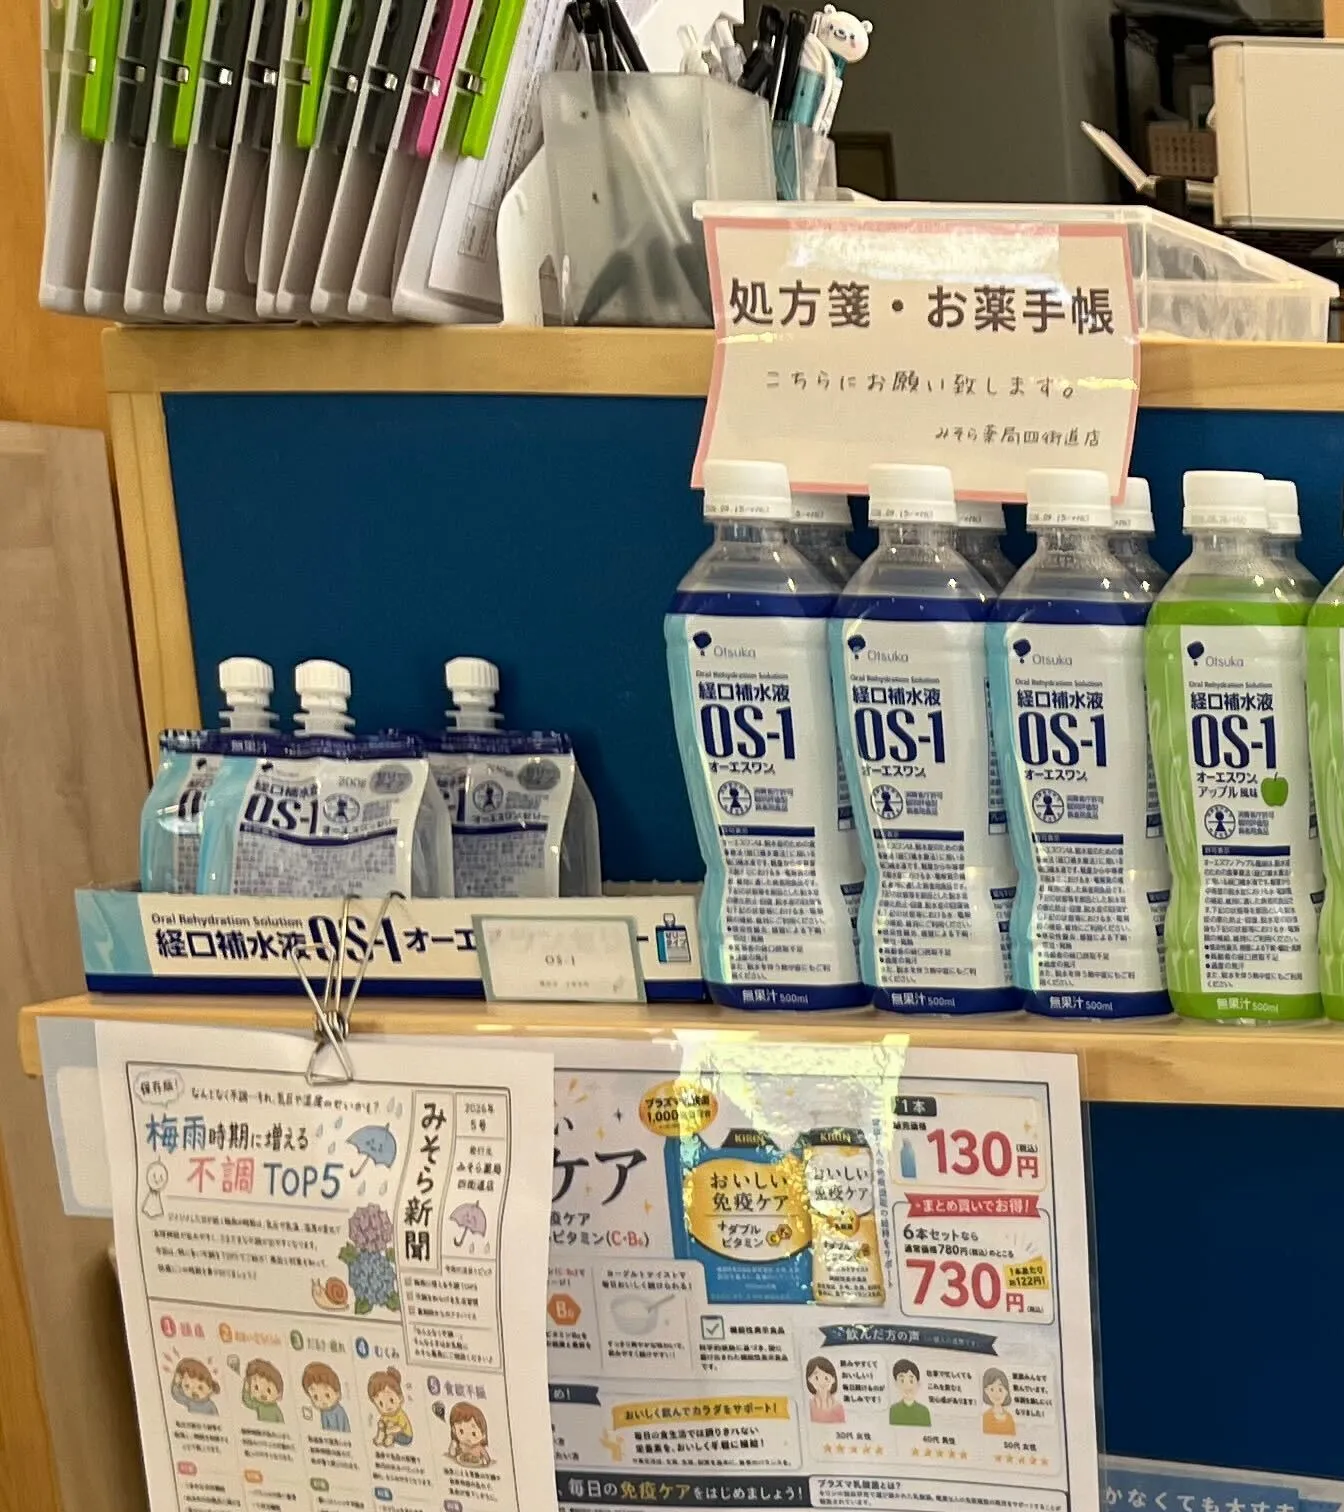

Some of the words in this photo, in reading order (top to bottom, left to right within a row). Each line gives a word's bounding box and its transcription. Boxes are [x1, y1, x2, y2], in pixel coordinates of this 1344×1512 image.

[729, 277, 1116, 336] 処方箋・お薬手帳
[766, 369, 1075, 399] こちらにお願い致します。
[935, 426, 1101, 447] みそら薬局四街道店
[699, 682, 790, 702] 経口補水液
[852, 684, 941, 706] 経口補水液
[1017, 690, 1104, 710] 経口補水液
[1191, 692, 1273, 711] 経口補水液
[700, 703, 796, 760] OS-1
[854, 706, 946, 764] OS-1
[1017, 711, 1107, 768] OS-1
[1191, 714, 1277, 770] OS-1
[1198, 786, 1258, 800] アップル風味
[244, 793, 319, 835] OS-1
[151, 913, 176, 924] Oral
[179, 914, 251, 928] Rehydration
[253, 916, 303, 928] Solution
[901, 1099, 926, 1113] 1本
[145, 1113, 309, 1153] 梅雨時期に増える
[926, 1128, 1012, 1177] 130
[1017, 1156, 1038, 1178] 円
[187, 1156, 256, 1196] 不調
[263, 1162, 345, 1200] TOP5
[404, 1102, 446, 1263] みそら新聞
[710, 1172, 788, 1190] おいしい
[713, 1193, 788, 1212] 免疫ケア
[922, 1199, 1030, 1213] まとめ買いでお得!
[722, 1235, 764, 1249] ビタミン
[903, 1224, 978, 1242] 6本セットなら
[906, 1258, 1002, 1310] 730
[1007, 1292, 1024, 1313] 円
